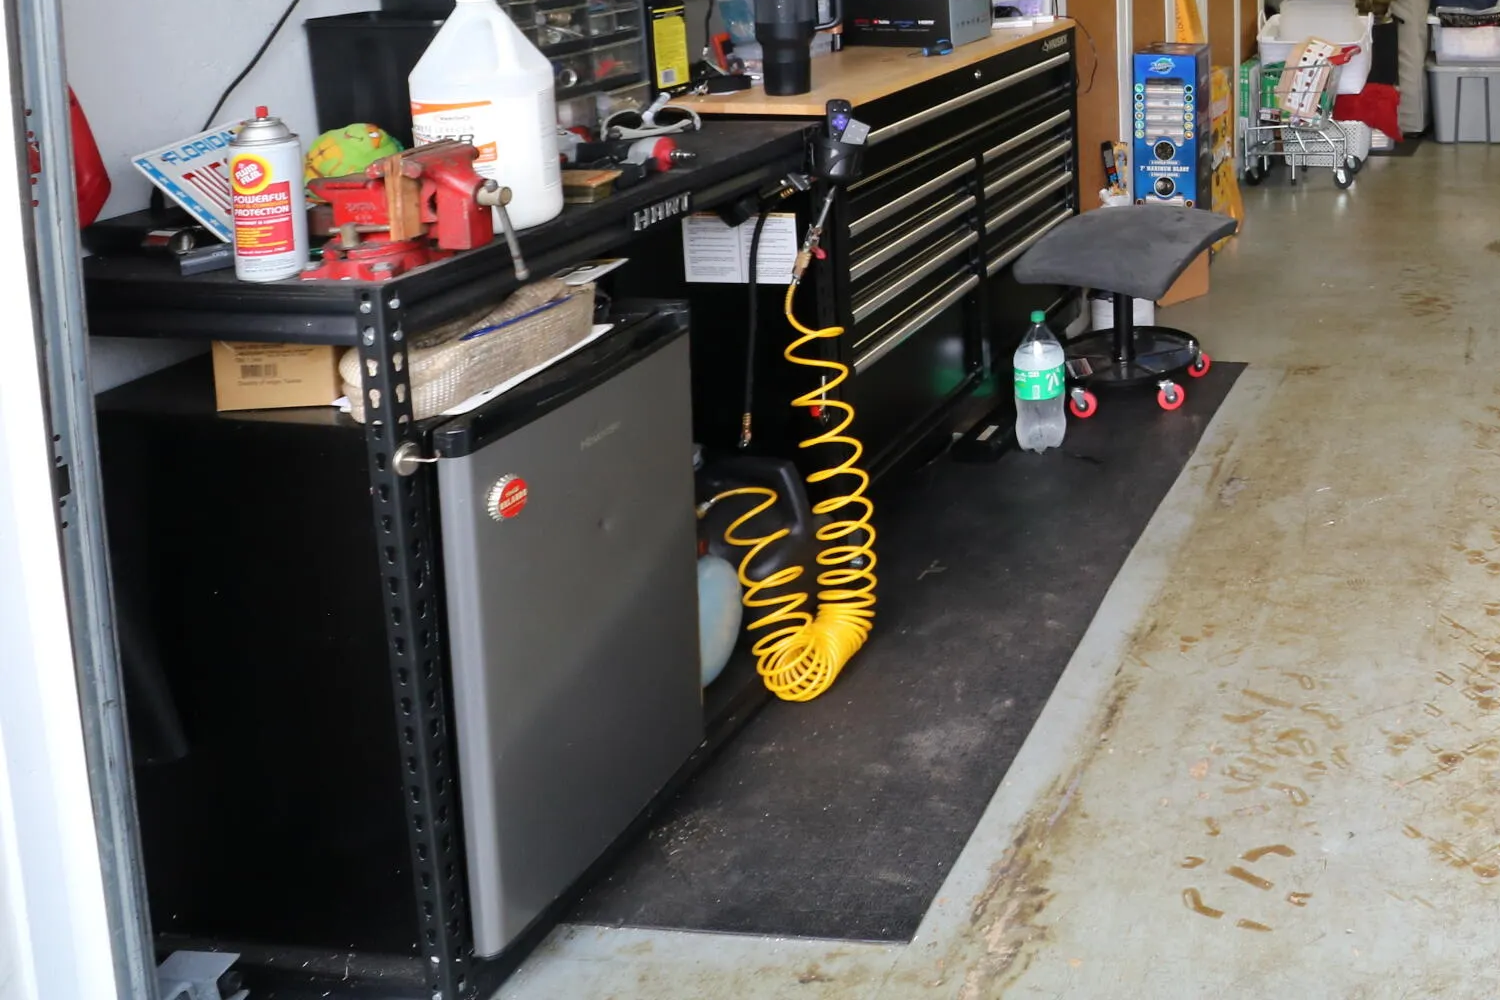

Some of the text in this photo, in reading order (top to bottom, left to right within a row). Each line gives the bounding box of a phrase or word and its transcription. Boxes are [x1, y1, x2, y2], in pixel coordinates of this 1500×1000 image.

[161, 130, 236, 165] FLORIDA
[235, 163, 259, 180] FLUID
[240, 171, 264, 186] FILM
[233, 192, 289, 204] POWERFUL
[234, 205, 290, 217] PROTECTION
[633, 191, 692, 231] HART
